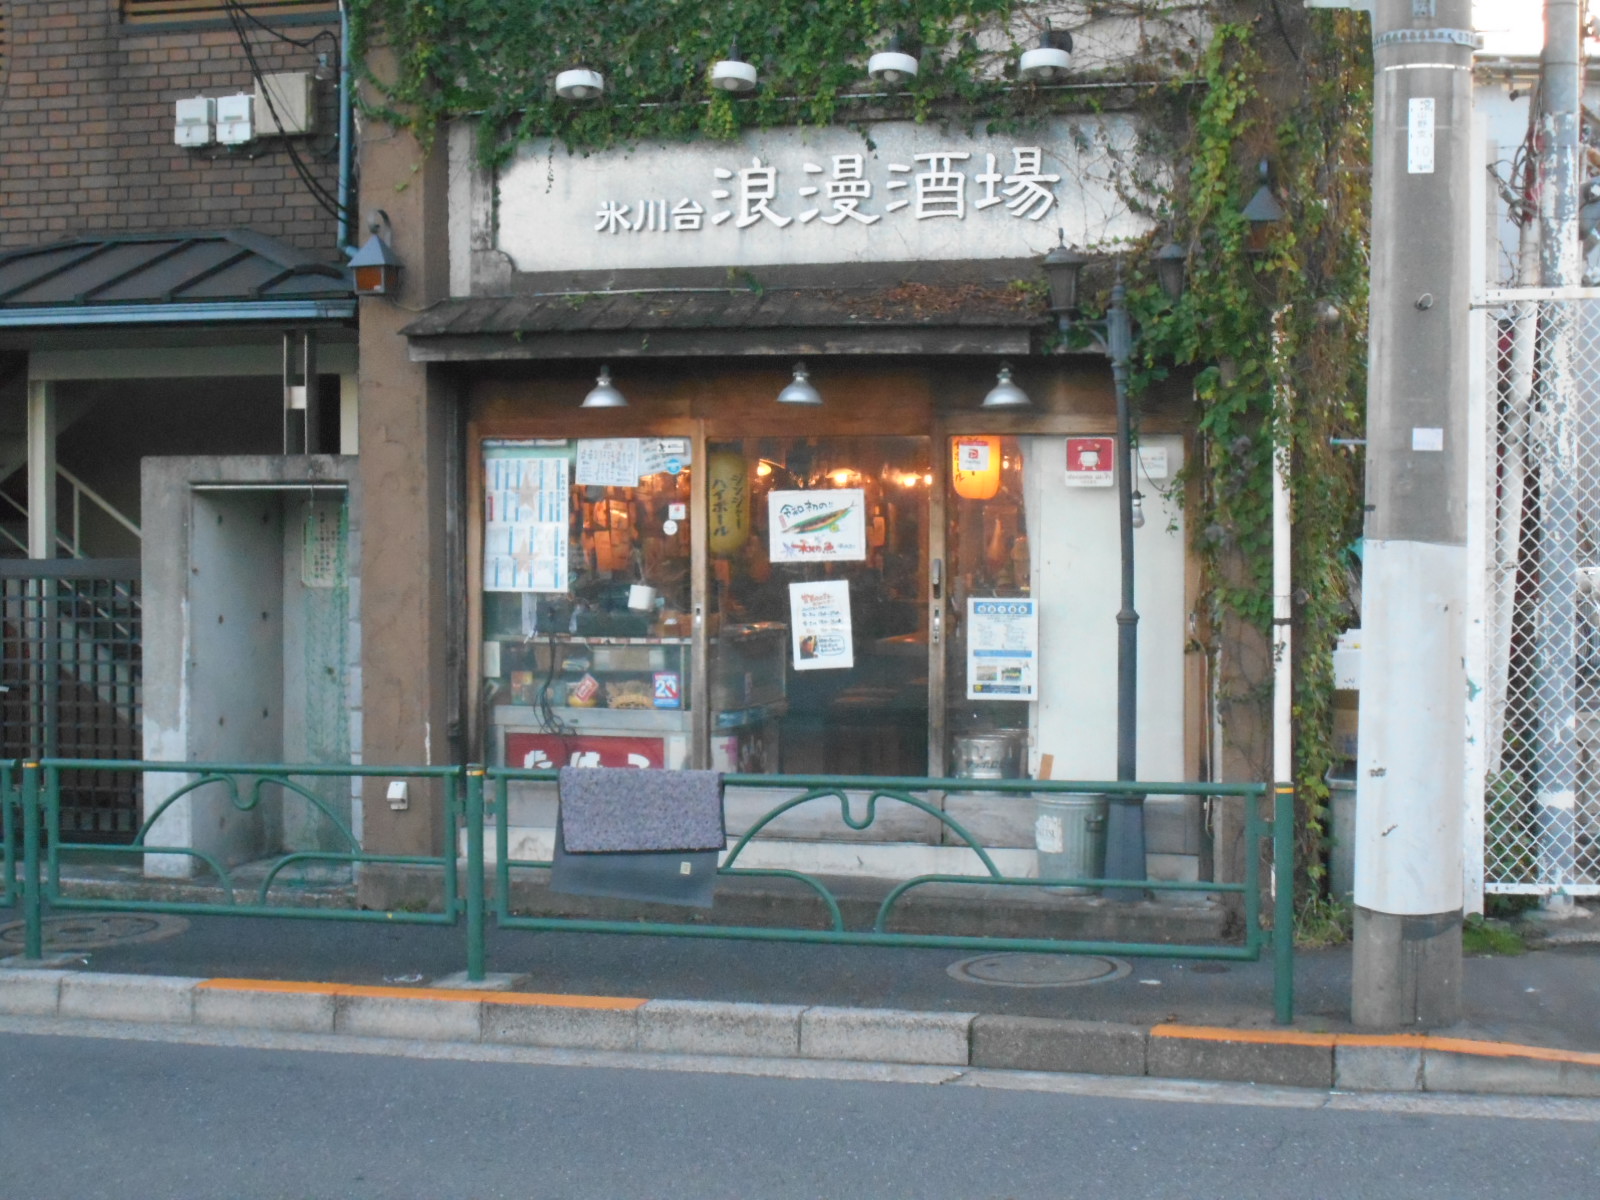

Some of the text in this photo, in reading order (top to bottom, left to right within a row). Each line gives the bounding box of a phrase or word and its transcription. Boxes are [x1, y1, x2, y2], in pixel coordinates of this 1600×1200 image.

[593, 145, 1062, 234] 氷川台 浪漫酒場
